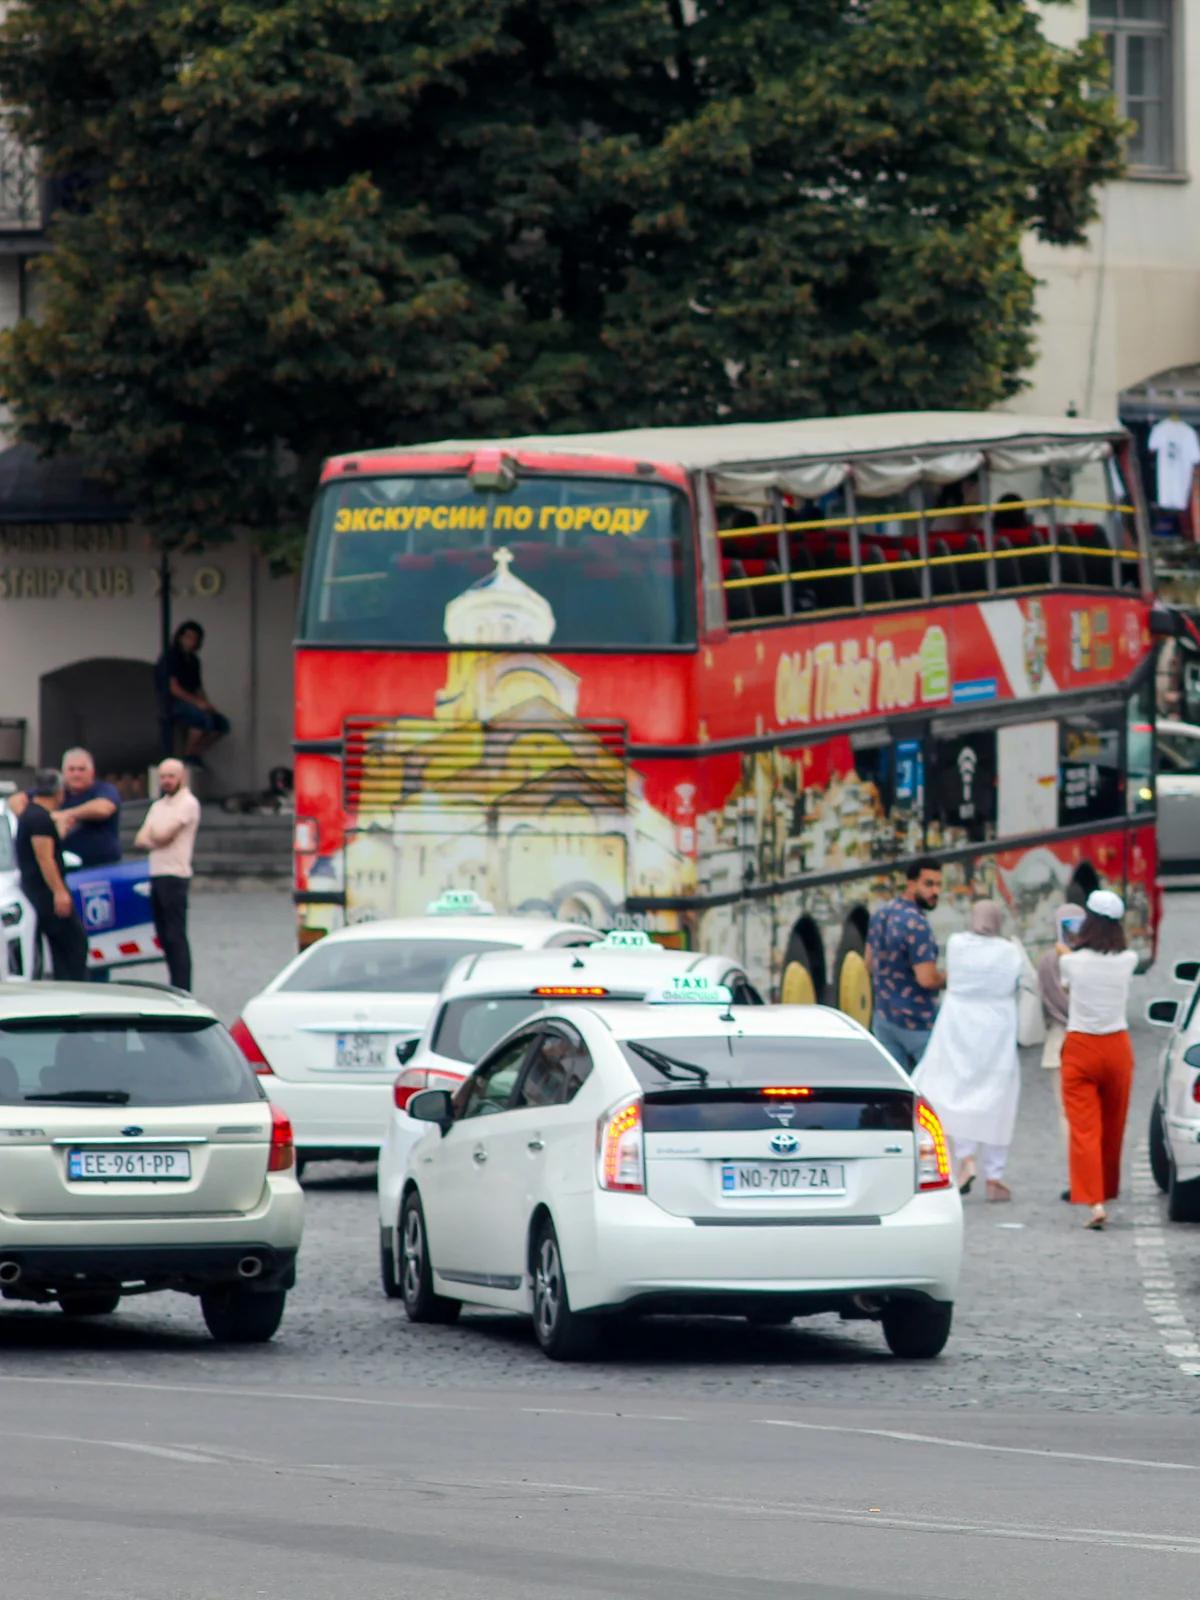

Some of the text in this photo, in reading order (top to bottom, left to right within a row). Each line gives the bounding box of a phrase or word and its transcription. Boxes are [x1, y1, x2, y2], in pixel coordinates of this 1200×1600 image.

[334, 504, 649, 535] ЭКСКУРСИИ ПО ГОРОДУ
[611, 935, 644, 946] TAXI
[673, 976, 708, 989] TAXI
[84, 1154, 175, 1174] EE-961-PP
[739, 1168, 830, 1188] NO-707-ZA
